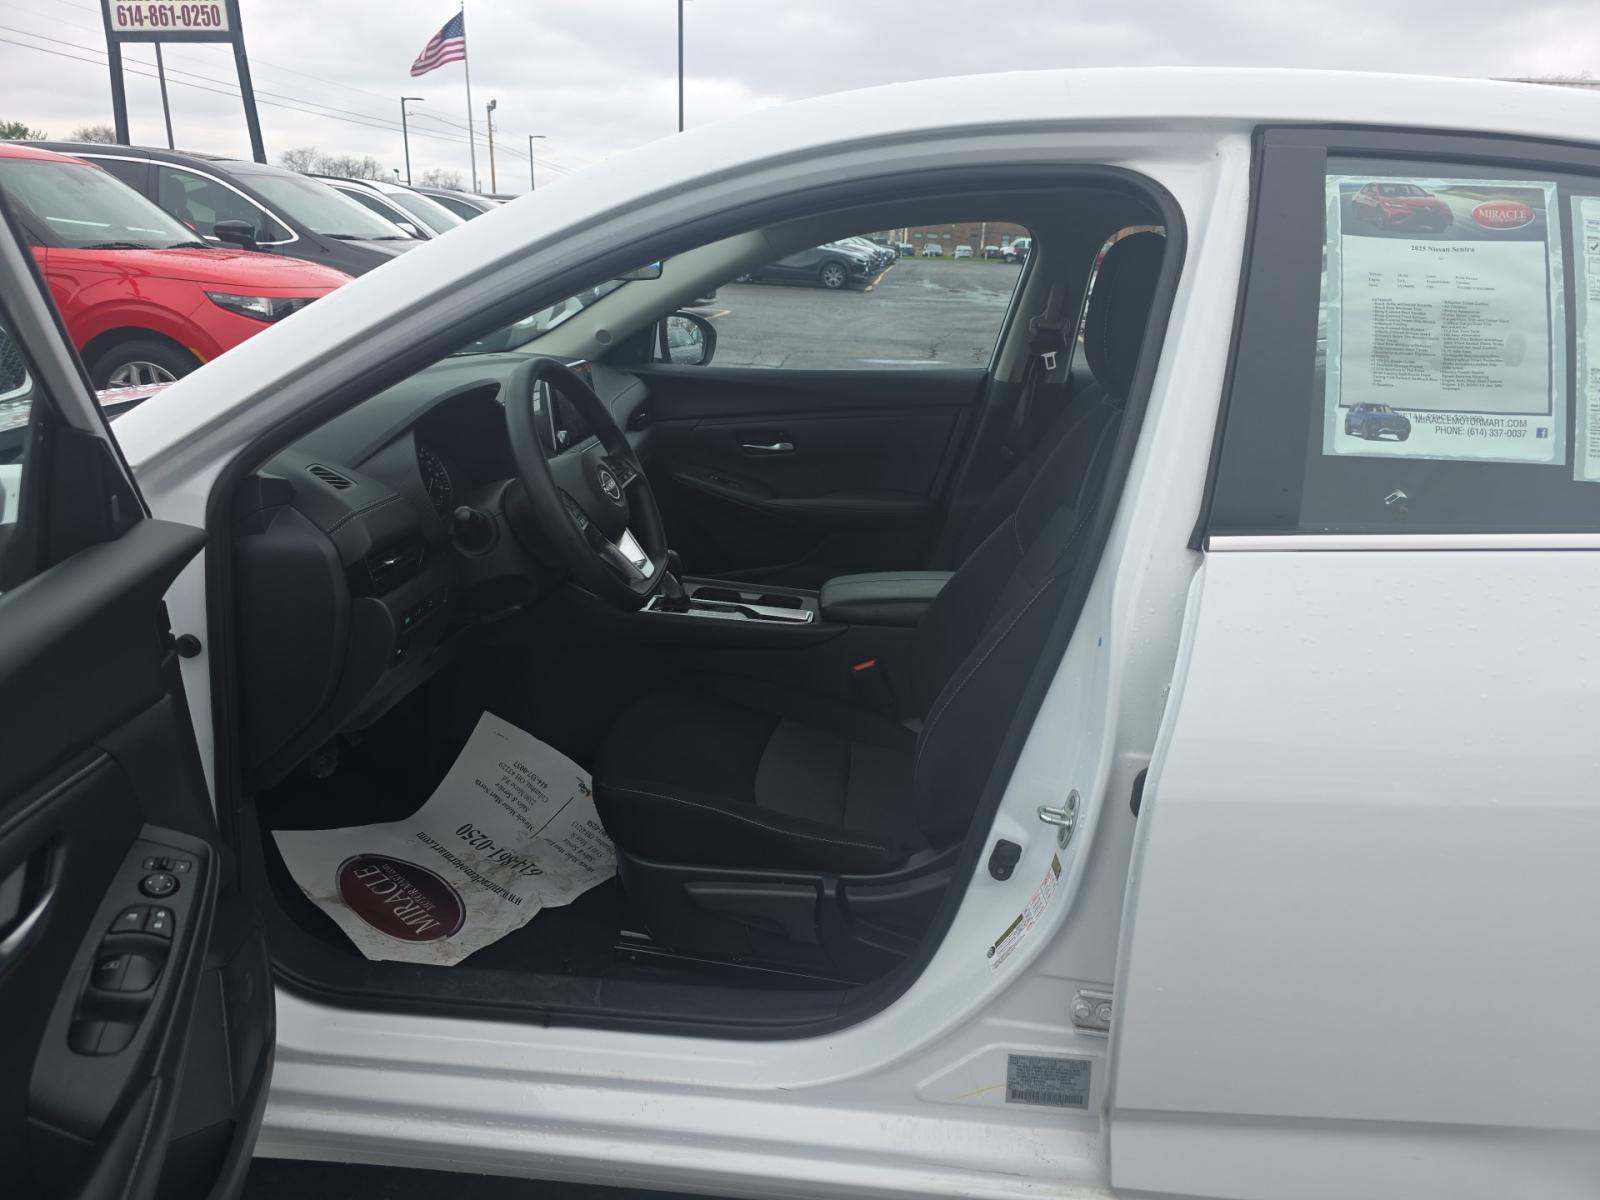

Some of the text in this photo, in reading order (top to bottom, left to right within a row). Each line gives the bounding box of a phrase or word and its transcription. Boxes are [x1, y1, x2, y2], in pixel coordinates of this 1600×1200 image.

[116, 4, 221, 27] 614-861-0250
[1478, 208, 1529, 219] MIRACLE
[1435, 426, 1527, 438] PHONE: (614) 337-0037
[416, 831, 523, 906] www.miraclemotormart.com
[455, 823, 543, 876] 614-861-0250
[353, 865, 440, 934] MIRACLE
